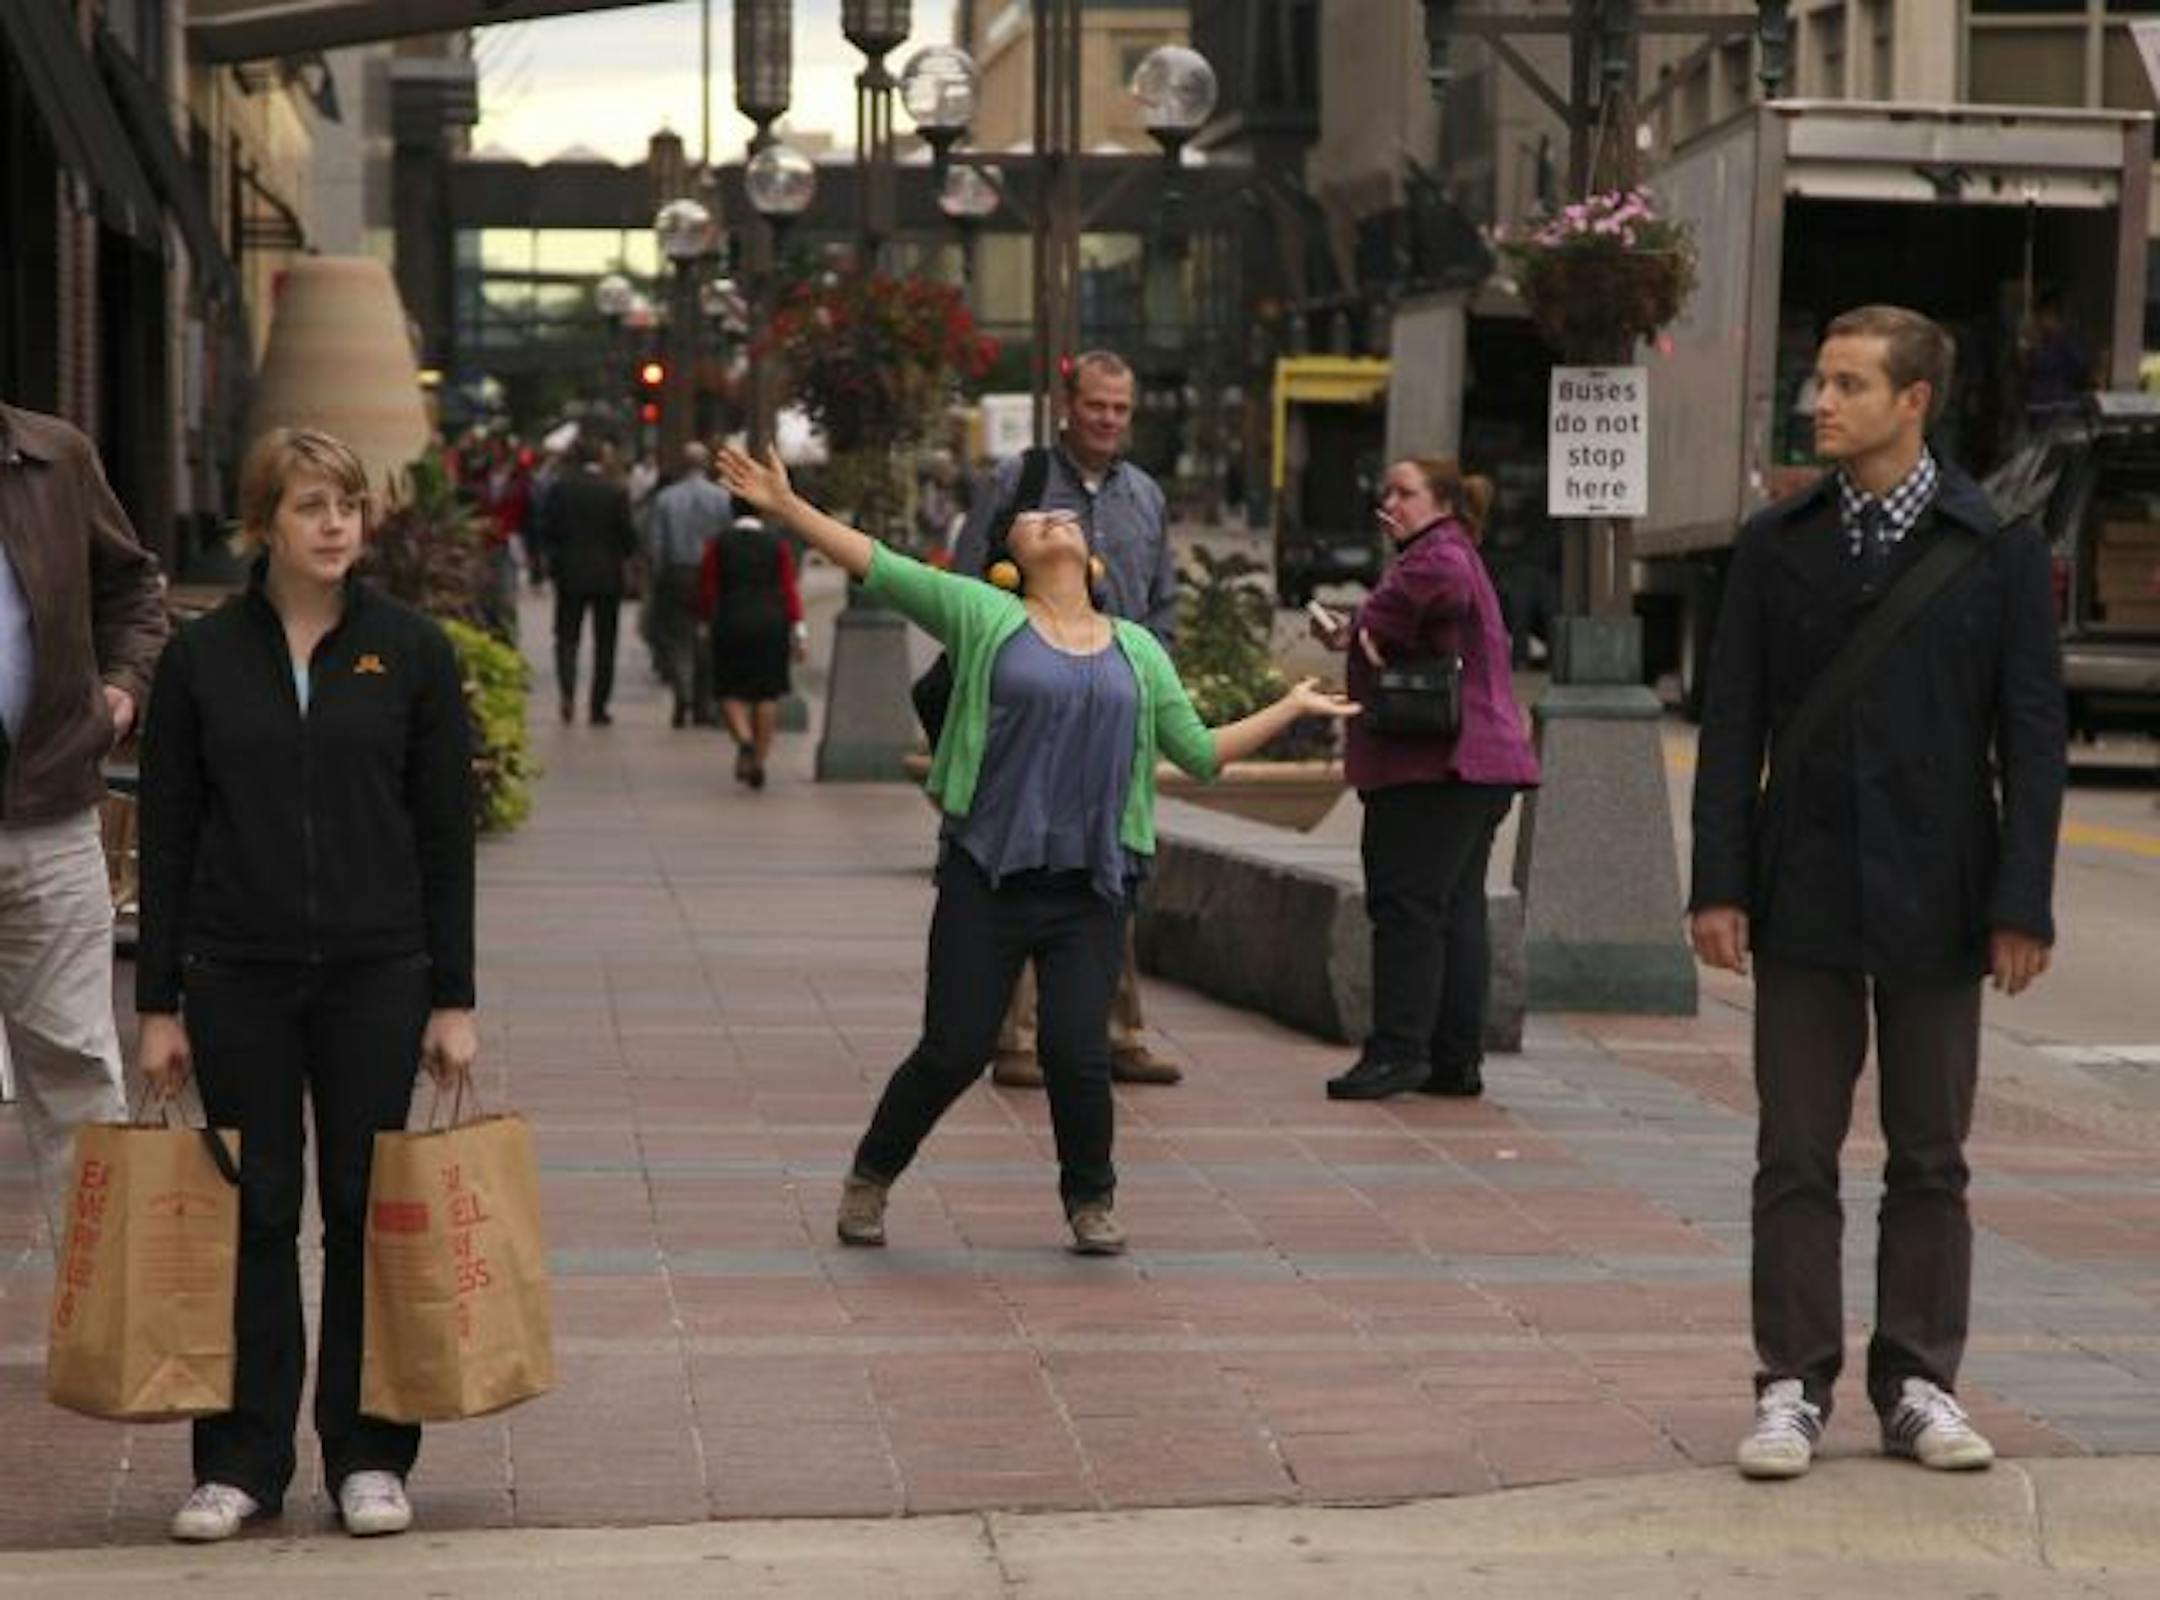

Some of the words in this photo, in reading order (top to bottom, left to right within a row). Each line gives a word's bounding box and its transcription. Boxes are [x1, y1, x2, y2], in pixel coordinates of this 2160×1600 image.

[1558, 381, 1637, 401] Buses
[1555, 413, 1587, 433] do
[1595, 413, 1639, 433] not
[1568, 445, 1625, 469] stop
[1566, 477, 1626, 498] here
